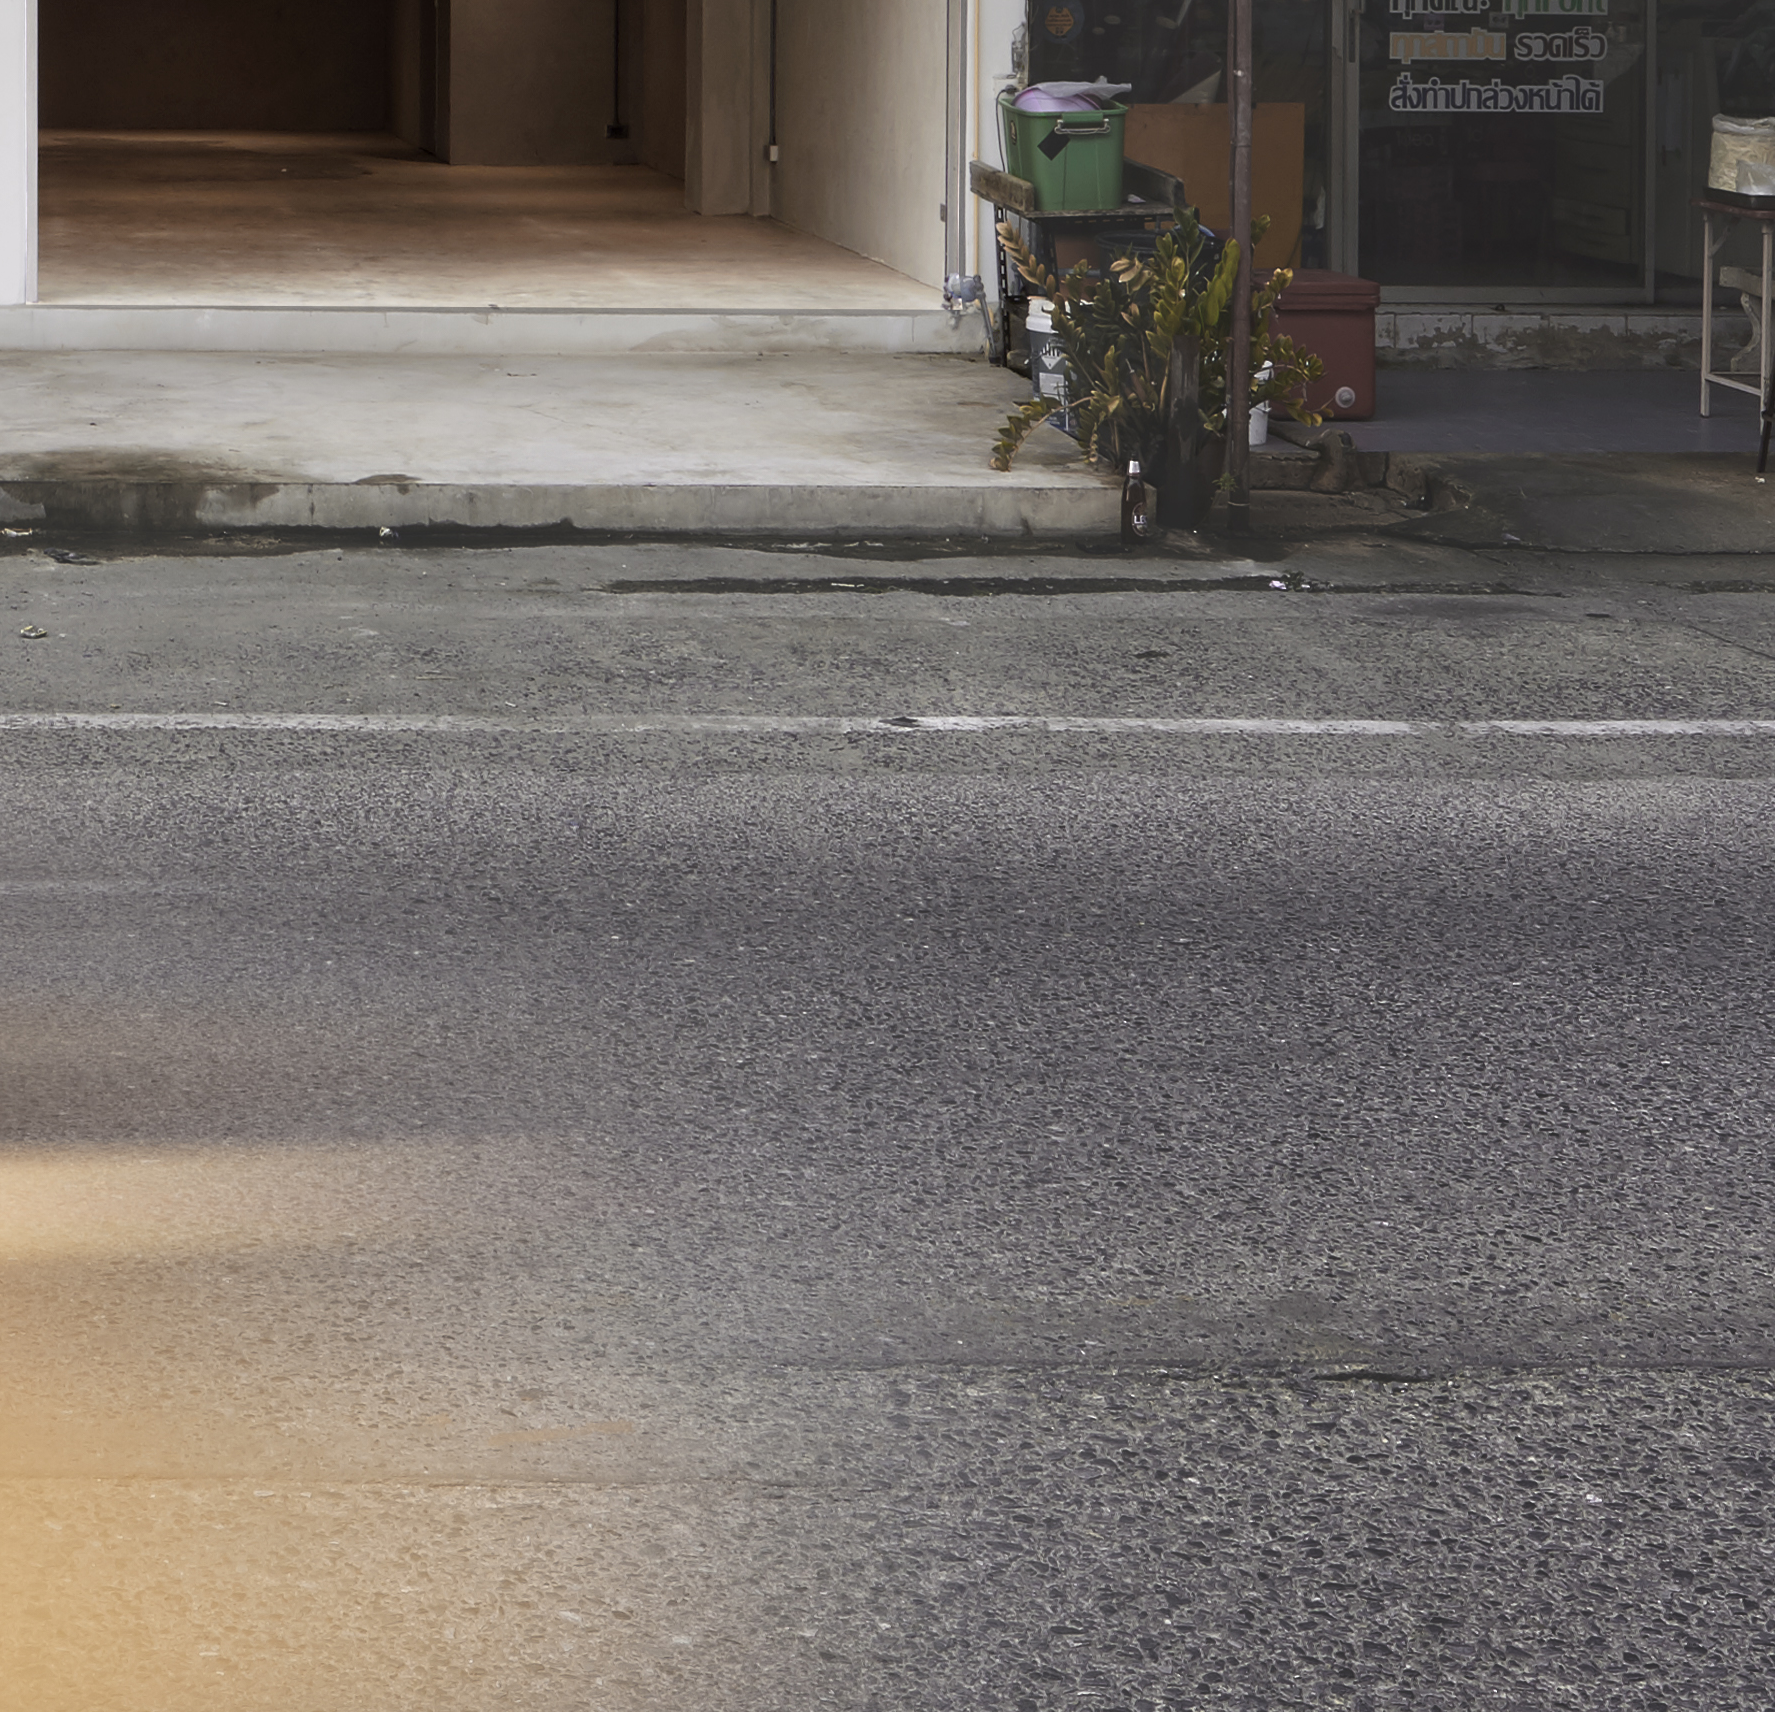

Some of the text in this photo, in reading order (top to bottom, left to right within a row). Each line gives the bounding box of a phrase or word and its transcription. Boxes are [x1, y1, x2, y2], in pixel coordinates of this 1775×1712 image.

[1514, 26, 1608, 61] รวดเร็ว
[1389, 72, 1604, 113] สั่งทำปกล่วงหน้าได้
